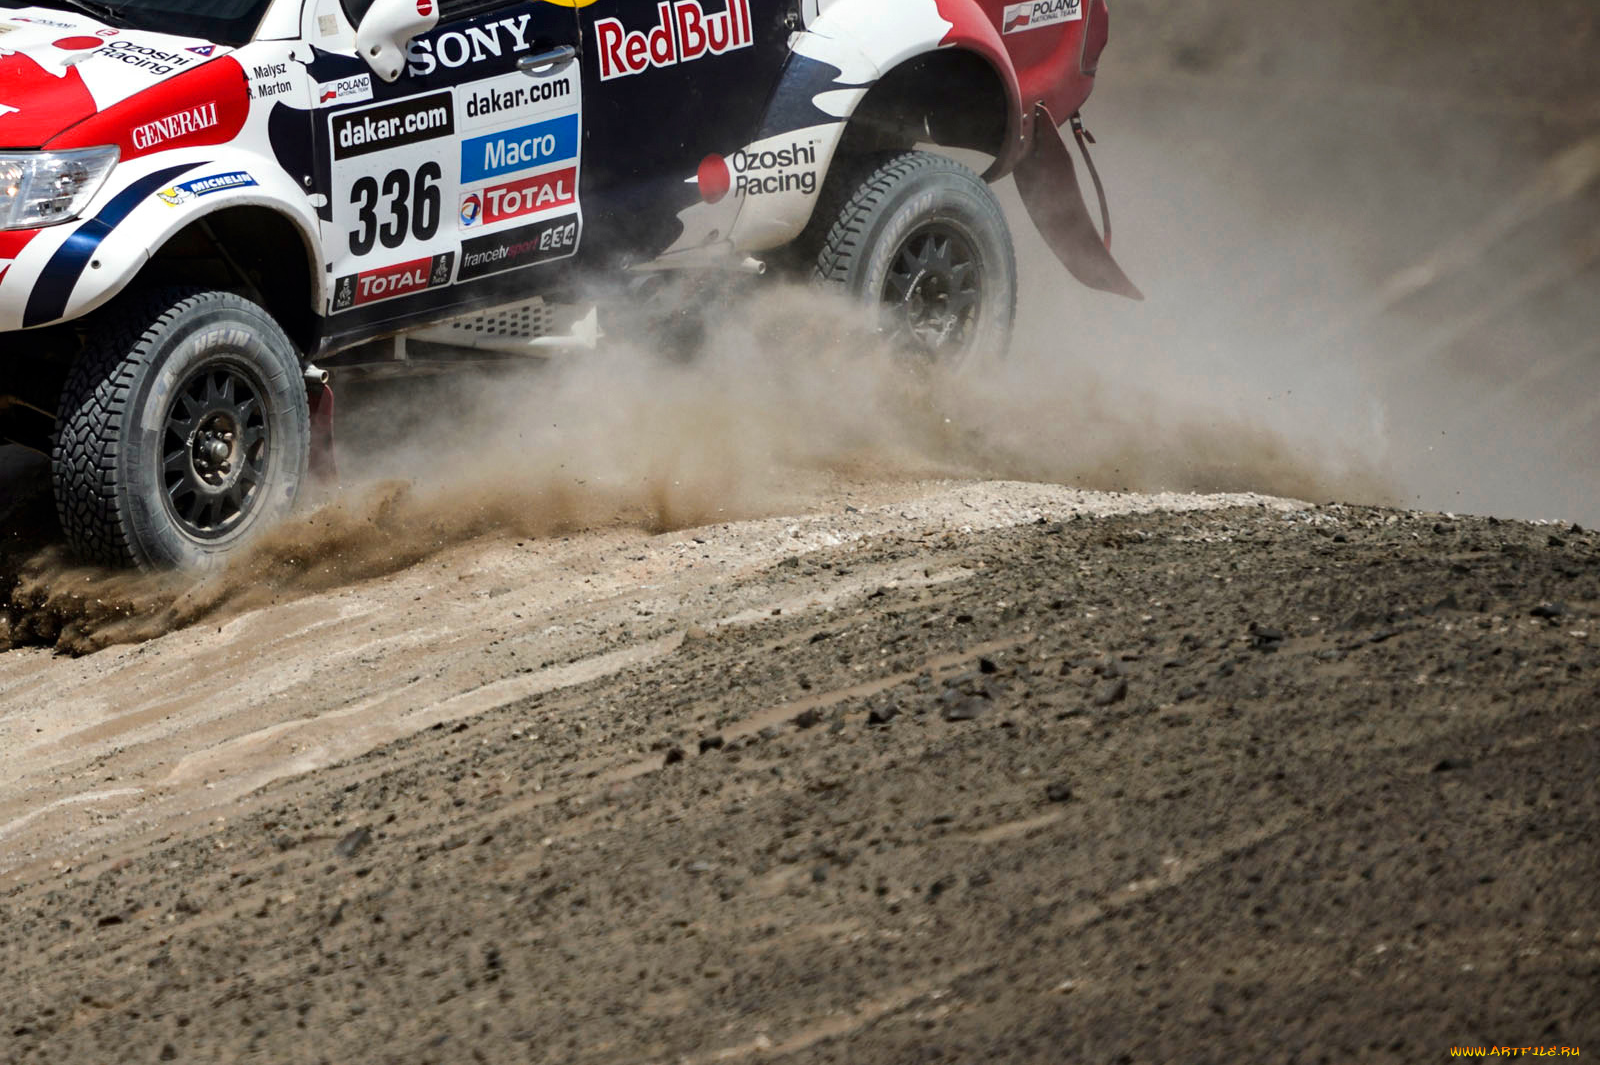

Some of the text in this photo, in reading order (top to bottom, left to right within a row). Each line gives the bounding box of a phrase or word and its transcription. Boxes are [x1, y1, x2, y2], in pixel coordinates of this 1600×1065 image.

[93, 47, 174, 76] Racing
[107, 40, 194, 66] Ozoshi
[408, 14, 532, 79] SONY
[253, 63, 287, 79] Malysz
[337, 76, 370, 93] POLAND
[258, 81, 293, 98] Marton
[466, 77, 571, 118] dakar.com
[132, 101, 219, 150] GENERALI
[339, 107, 448, 148] dakar.com
[483, 134, 556, 171] Macro
[732, 140, 816, 174] Ozoshi
[190, 172, 253, 193] MICHELIN
[486, 180, 572, 218] TOTAL
[734, 169, 817, 203] Racing
[349, 161, 442, 257] 336
[360, 269, 427, 296] TOTAL
